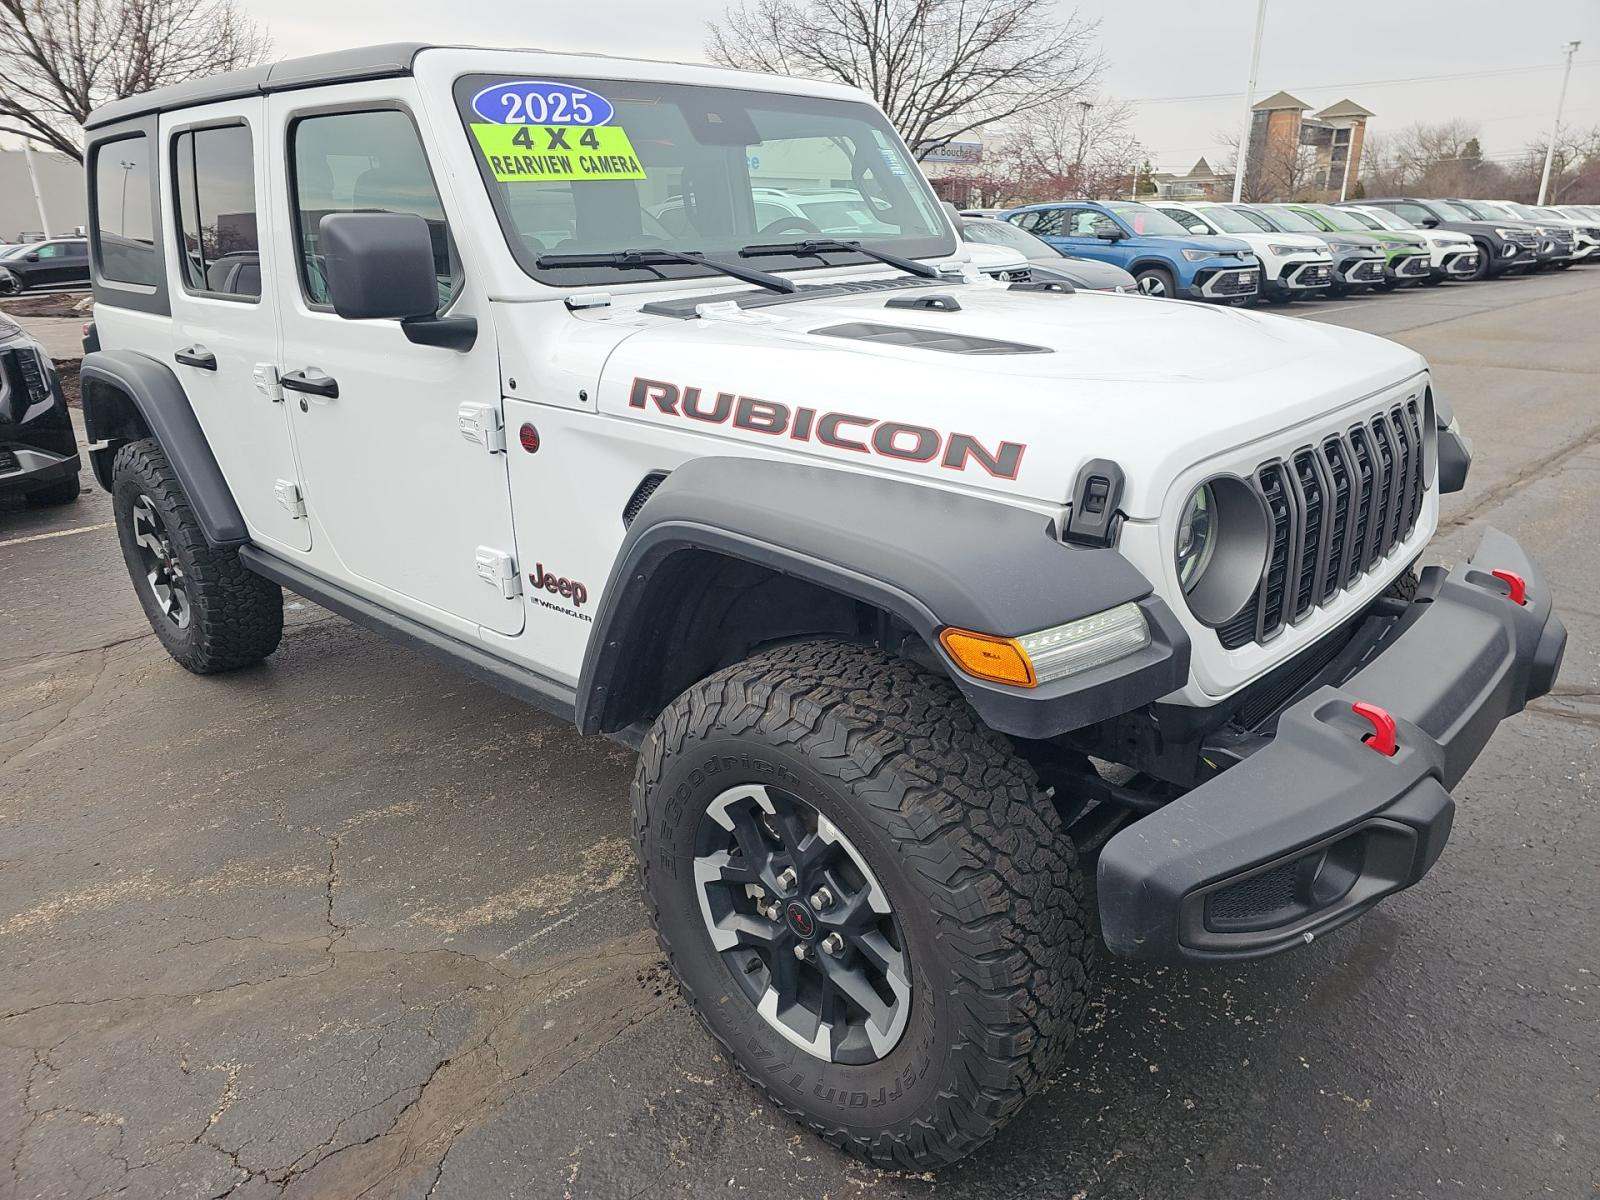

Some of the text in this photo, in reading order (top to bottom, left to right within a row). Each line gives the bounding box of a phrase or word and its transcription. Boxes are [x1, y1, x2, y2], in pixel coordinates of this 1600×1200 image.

[501, 92, 593, 124] 2025
[490, 155, 641, 175] REARVIEW CAMERA
[628, 376, 1027, 481] RUBICON
[528, 562, 588, 607] Jeep
[539, 600, 592, 623] WRANGLER
